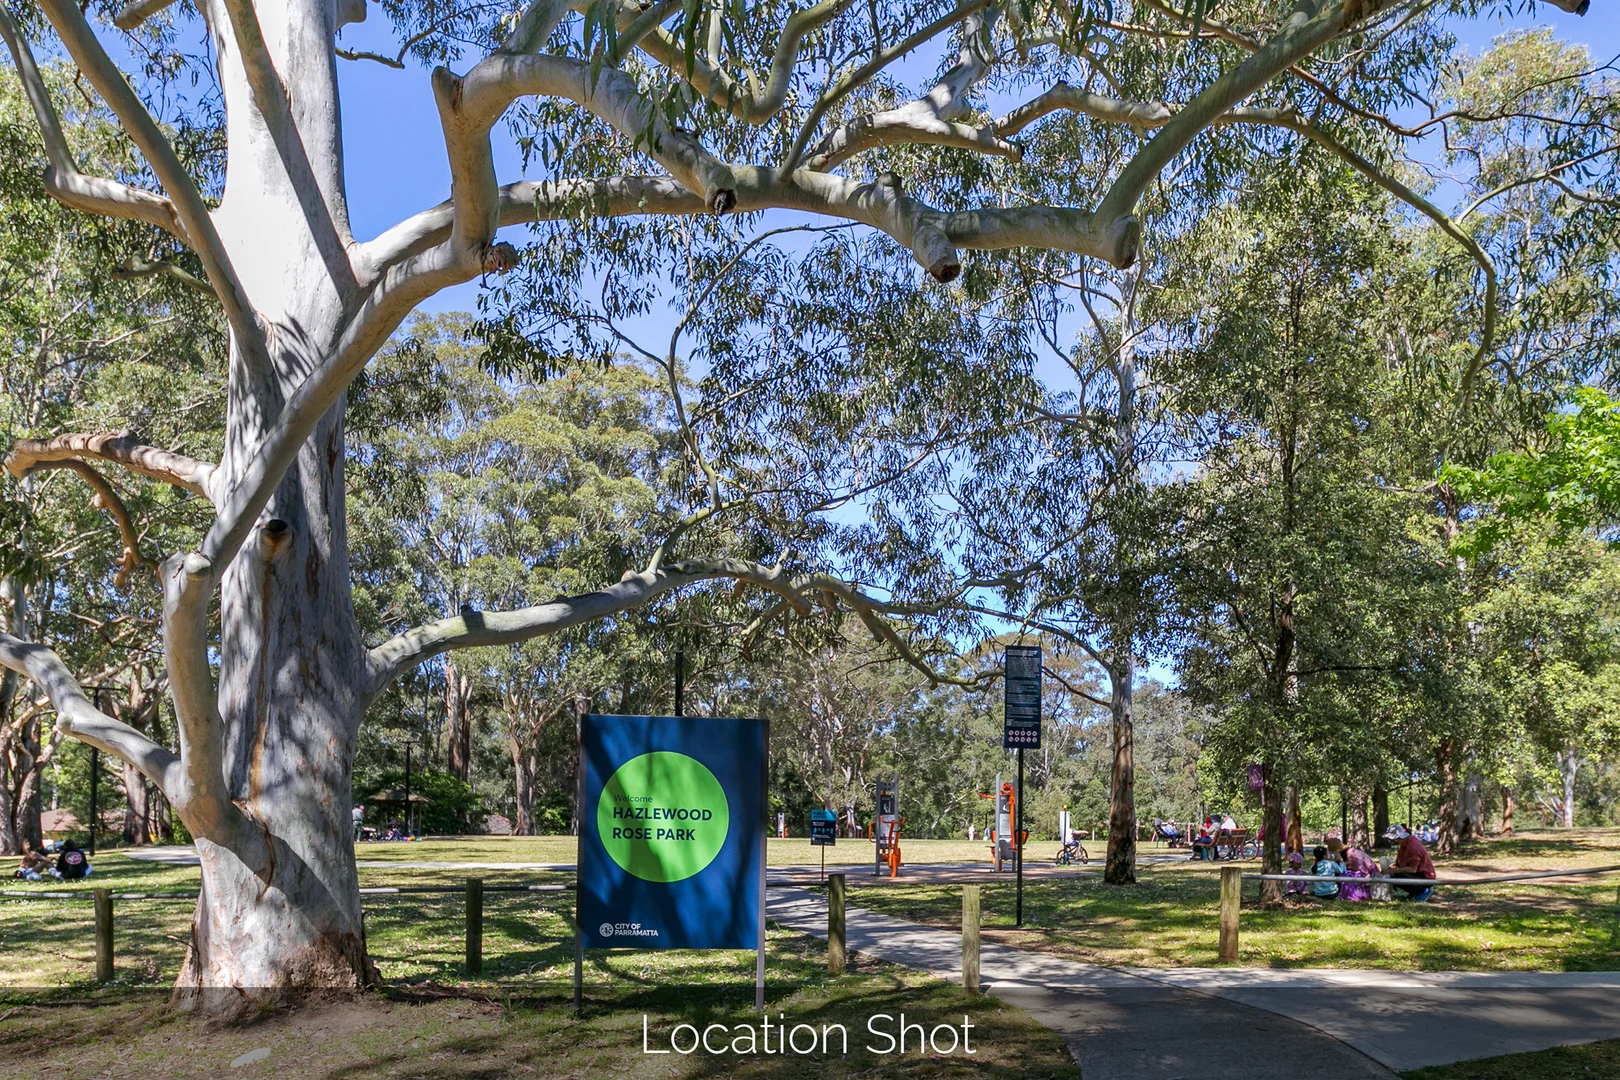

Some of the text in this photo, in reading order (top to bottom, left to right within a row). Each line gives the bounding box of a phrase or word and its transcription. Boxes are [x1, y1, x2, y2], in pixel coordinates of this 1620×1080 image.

[613, 794, 653, 803] Welcome
[613, 806, 713, 821] HAZLEWOOD
[612, 827, 696, 841] ROSE PARK
[614, 929, 659, 937] PARRAMATTA
